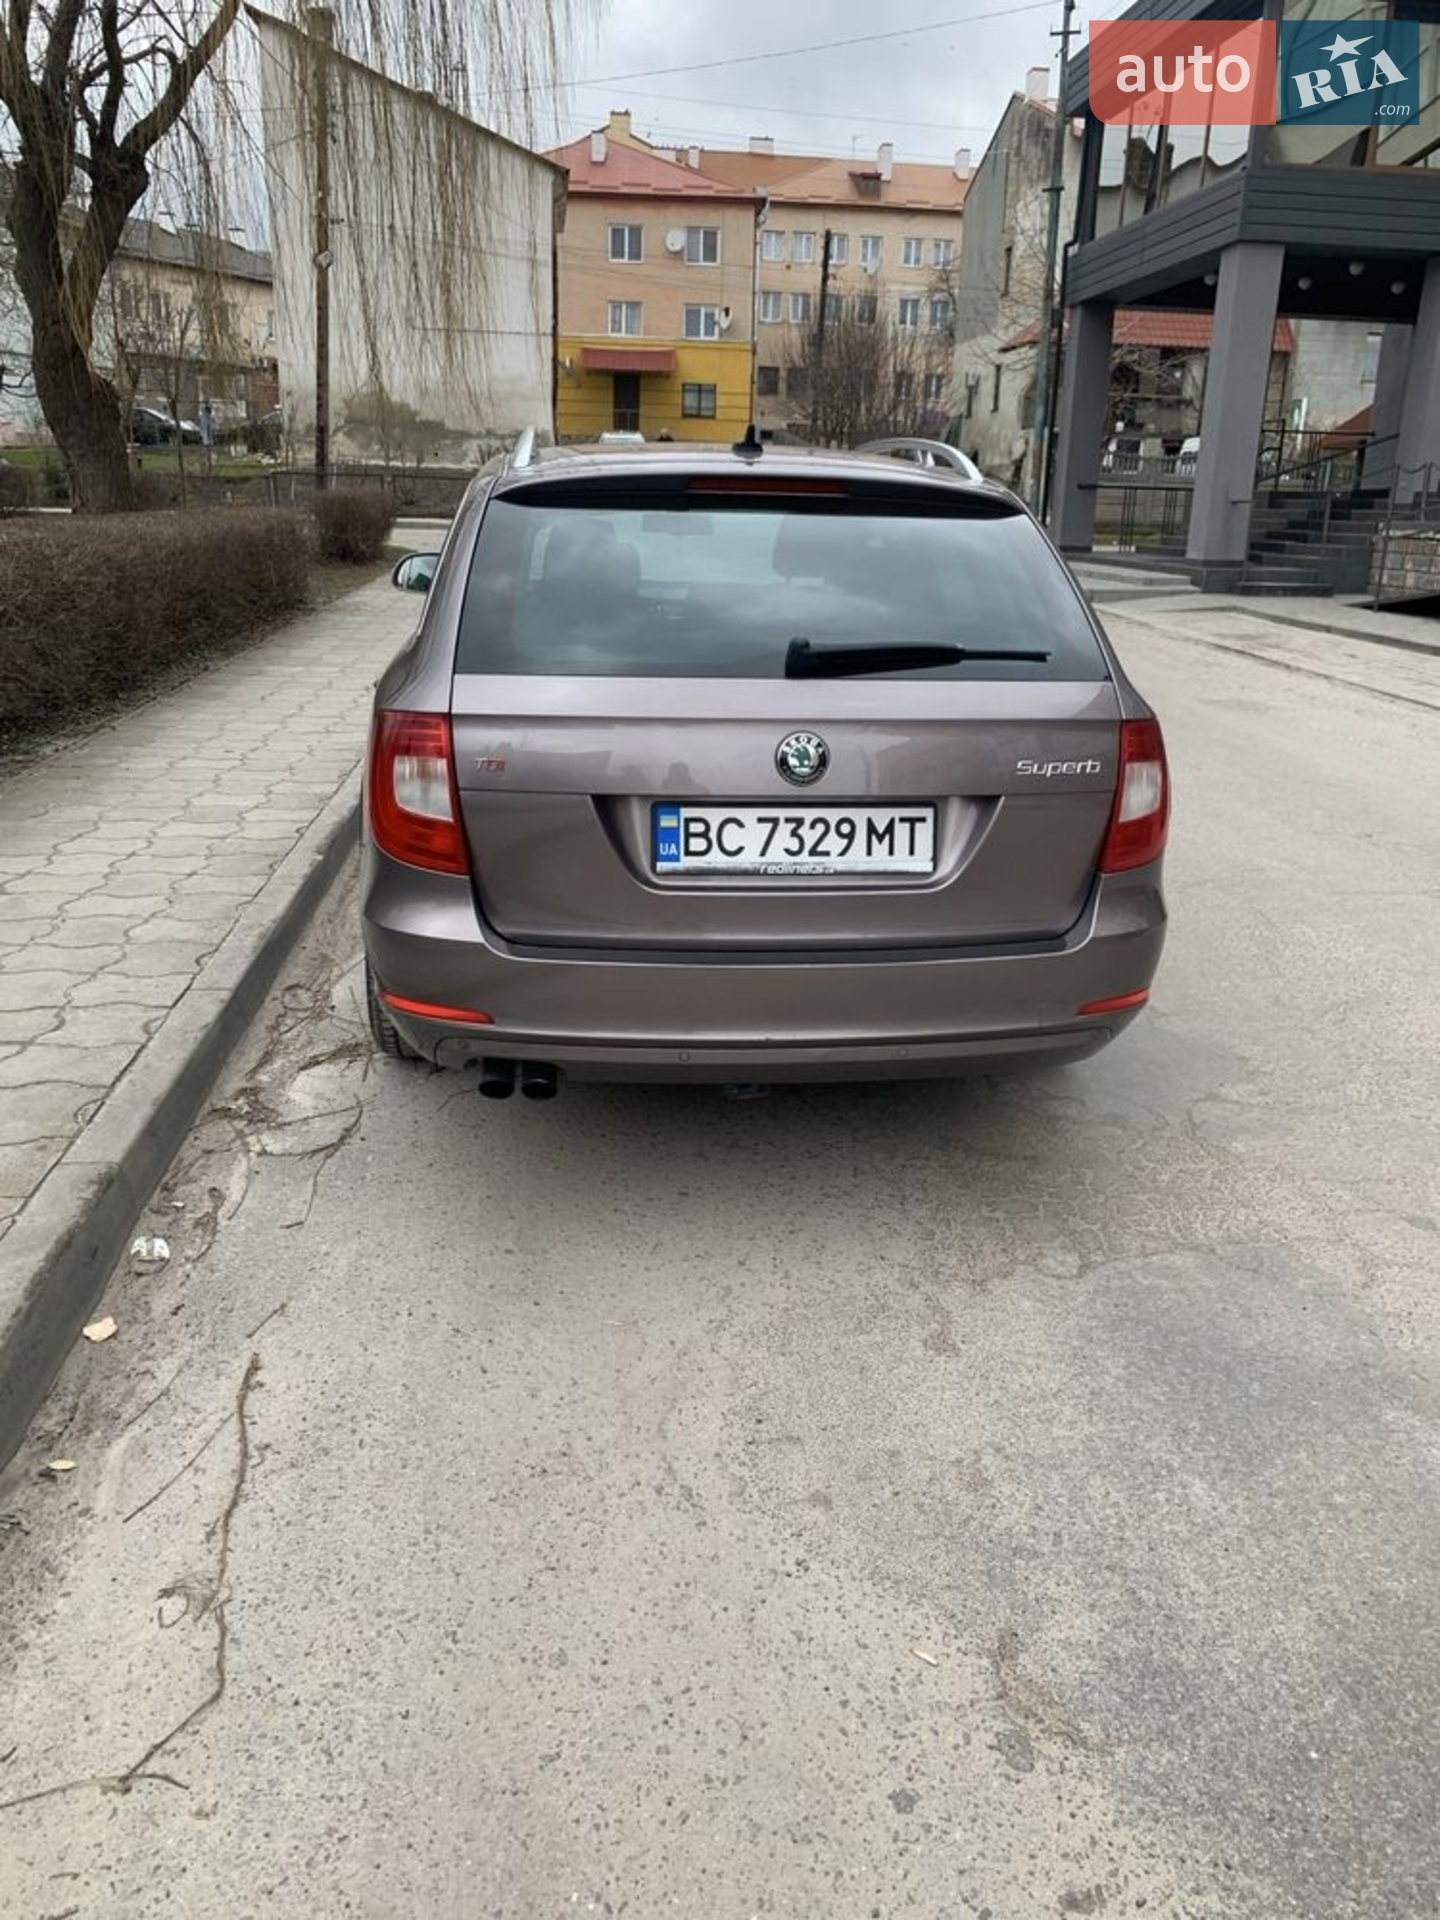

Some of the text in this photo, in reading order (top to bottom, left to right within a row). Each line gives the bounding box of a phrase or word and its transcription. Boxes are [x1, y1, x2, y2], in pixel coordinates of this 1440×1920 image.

[1016, 759, 1101, 777] Superb
[683, 816, 927, 857] BC 7329 MT
[660, 842, 678, 855] UA
